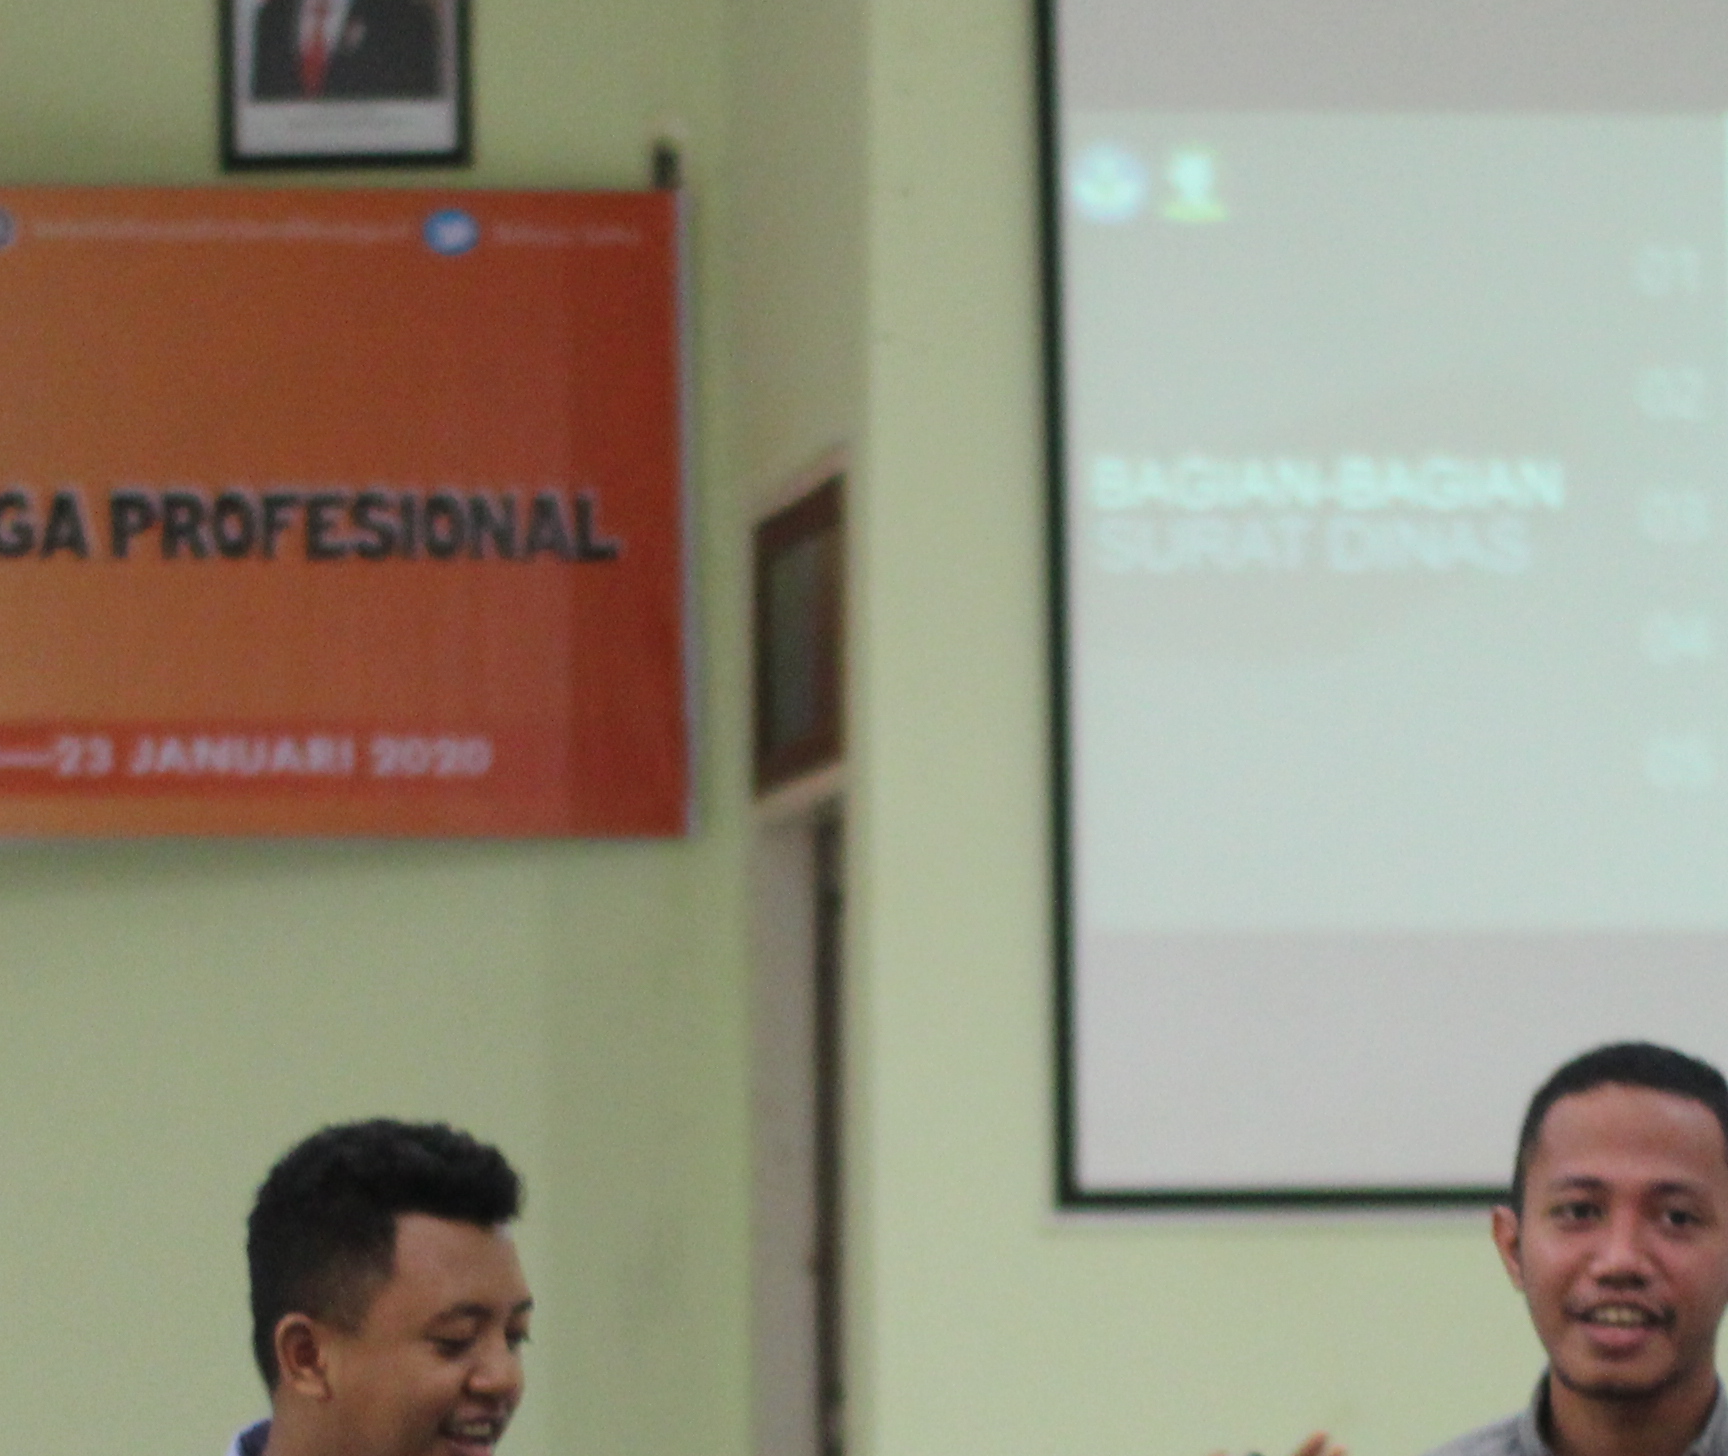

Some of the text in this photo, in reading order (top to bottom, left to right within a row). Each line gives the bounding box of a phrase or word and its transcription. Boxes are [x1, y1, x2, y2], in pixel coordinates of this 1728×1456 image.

[109, 488, 620, 564] PROFESIONAL
[1094, 516, 1534, 572] SURAT DINAS
[131, 736, 355, 777] JANUARI
[371, 736, 494, 777] 2020
